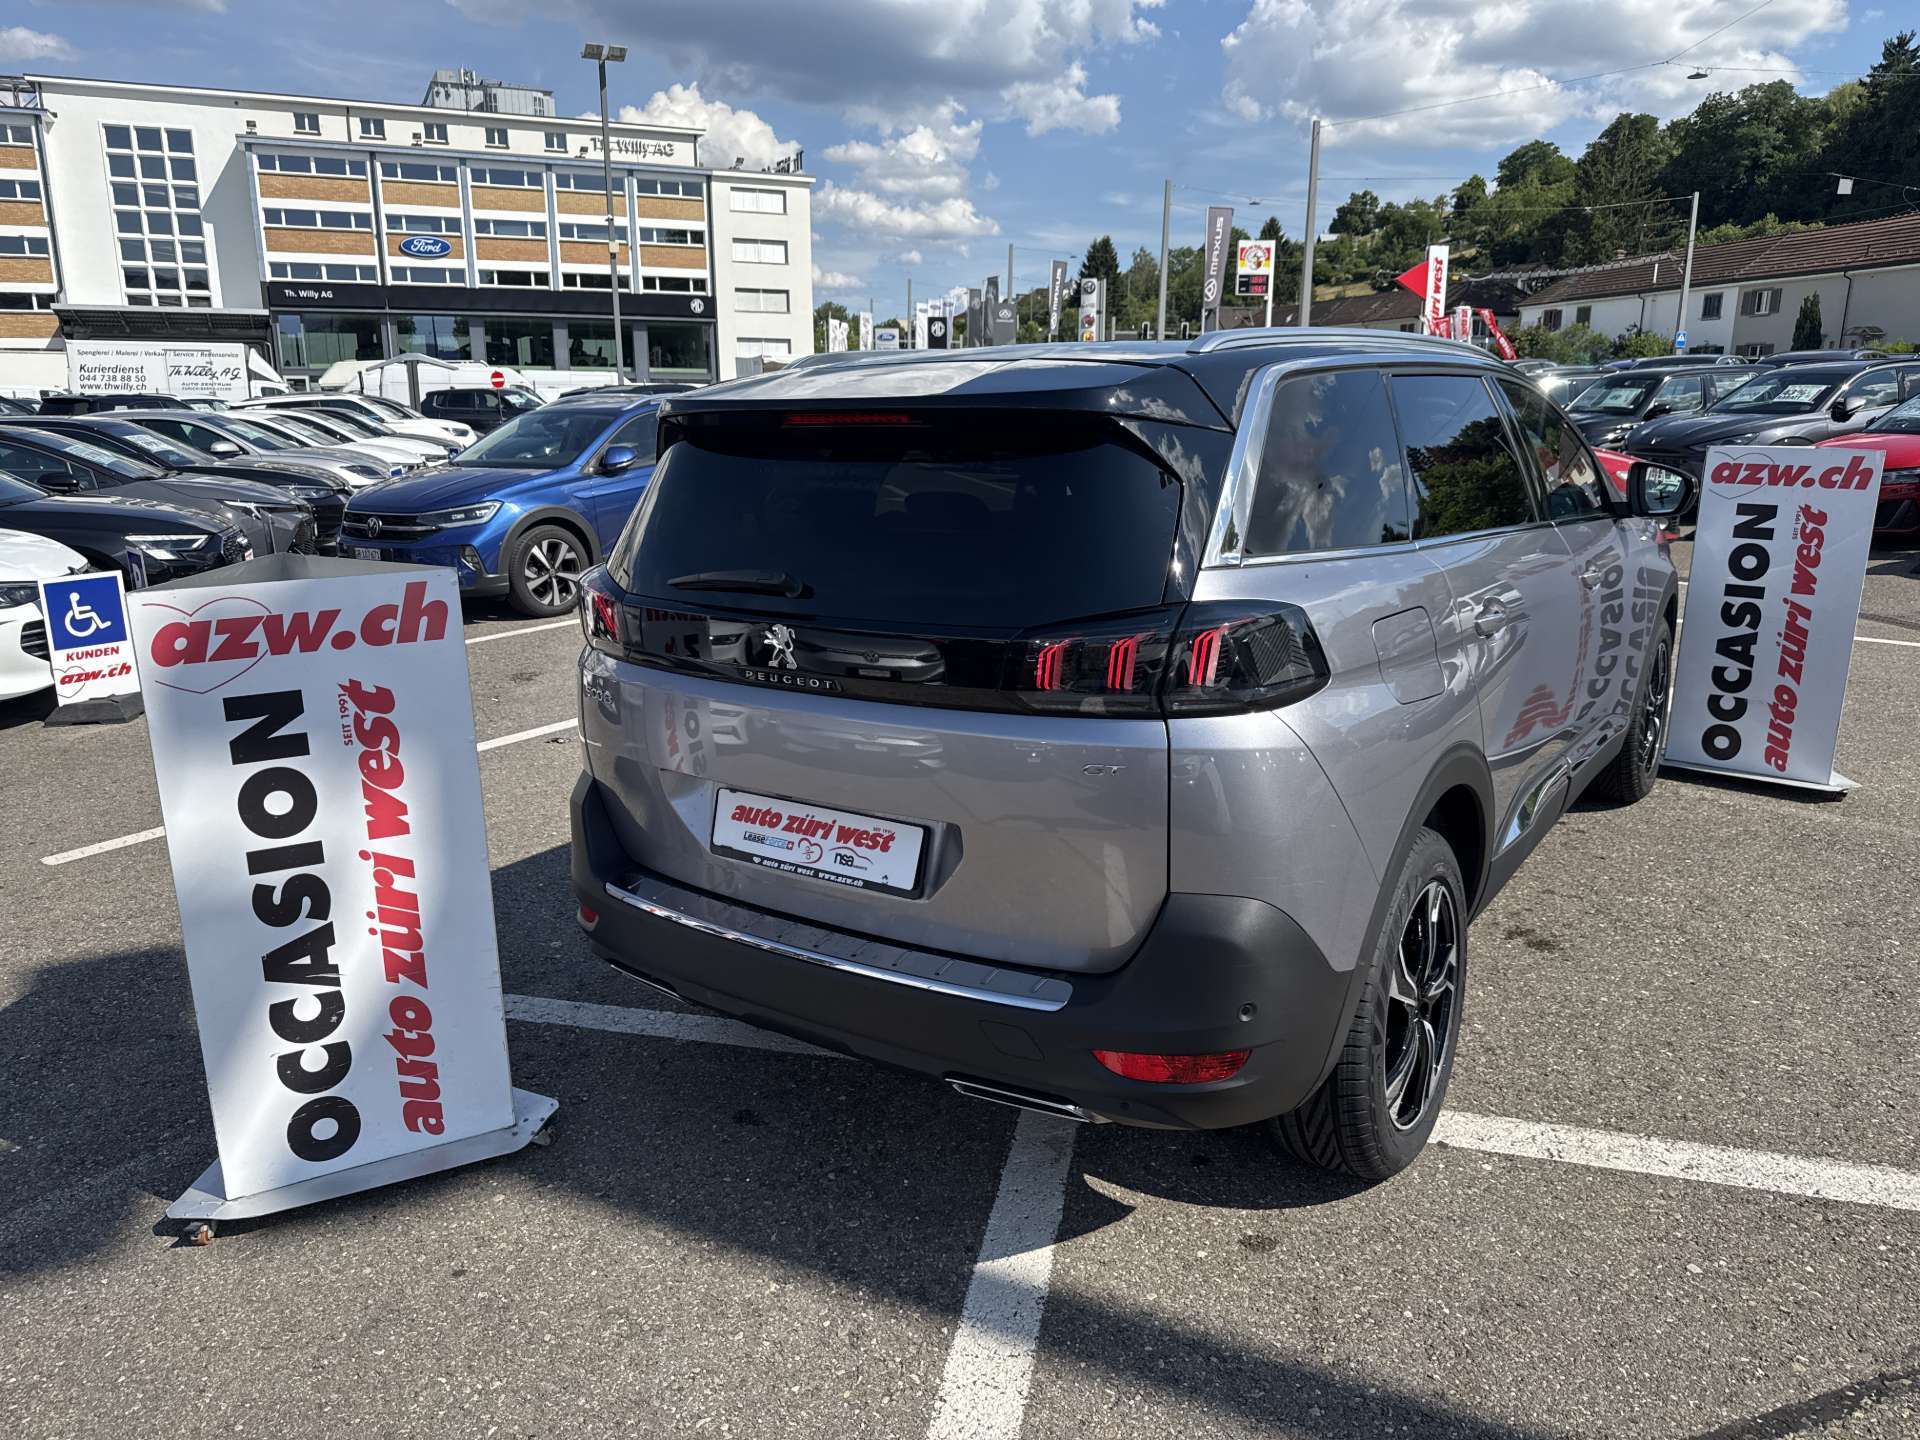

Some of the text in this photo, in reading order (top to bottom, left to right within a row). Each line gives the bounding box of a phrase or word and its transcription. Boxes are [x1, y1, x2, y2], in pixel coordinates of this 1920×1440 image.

[410, 238, 443, 255] Ford
[1209, 216, 1224, 275] MAXUS
[1432, 256, 1443, 294] west
[284, 289, 333, 299] Th. Willy AG
[931, 321, 945, 337] MG
[79, 364, 144, 374] Kurierdienst
[79, 382, 147, 391] www.thwilly.ch
[1711, 455, 1874, 491] azw.ch
[151, 581, 449, 667] azw.ch
[1702, 503, 1778, 761] OCCASION
[1764, 504, 1828, 772] auto züri west
[66, 646, 120, 662] KUNDEN
[60, 662, 132, 685] azw.ch
[745, 670, 833, 690] PEUGEOT
[338, 692, 353, 746] SEIT 1991
[1080, 763, 1128, 777] GT
[730, 804, 896, 852] auto züri west
[762, 859, 864, 888] auto züri west www.azw.ch
[833, 852, 854, 867] nsa
[337, 678, 445, 1136] auto züri west
[223, 689, 361, 1162] OCCASION
